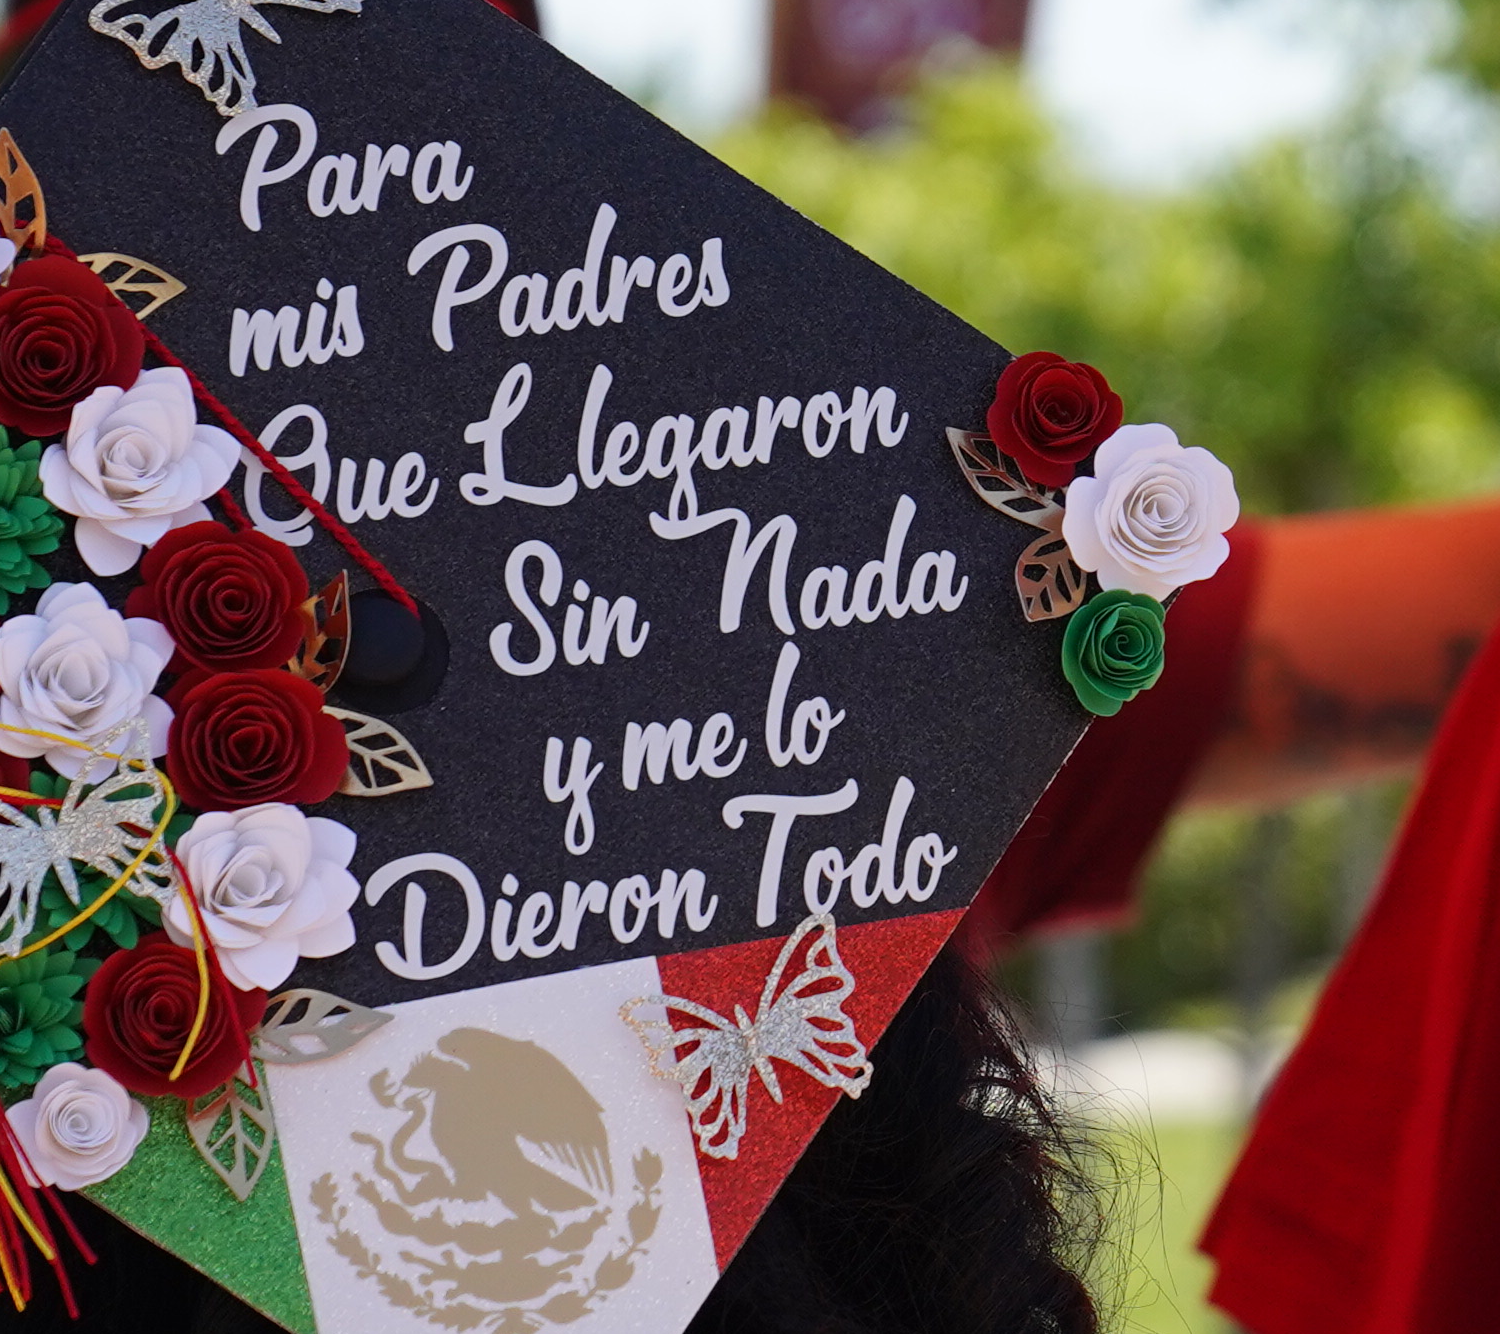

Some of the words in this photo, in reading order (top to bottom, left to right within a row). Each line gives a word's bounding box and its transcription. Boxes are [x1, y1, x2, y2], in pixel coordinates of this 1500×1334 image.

[214, 101, 475, 233] Para
[228, 278, 365, 378] mis
[406, 202, 731, 352] Padres
[241, 403, 440, 547] Que
[459, 362, 909, 524] Llegaron
[489, 539, 650, 677] Sin
[649, 493, 969, 636] Nada
[543, 735, 604, 856] y
[622, 711, 748, 792] me
[765, 641, 847, 768] lo
[364, 852, 719, 981] Dieron
[722, 775, 958, 928] Todo
